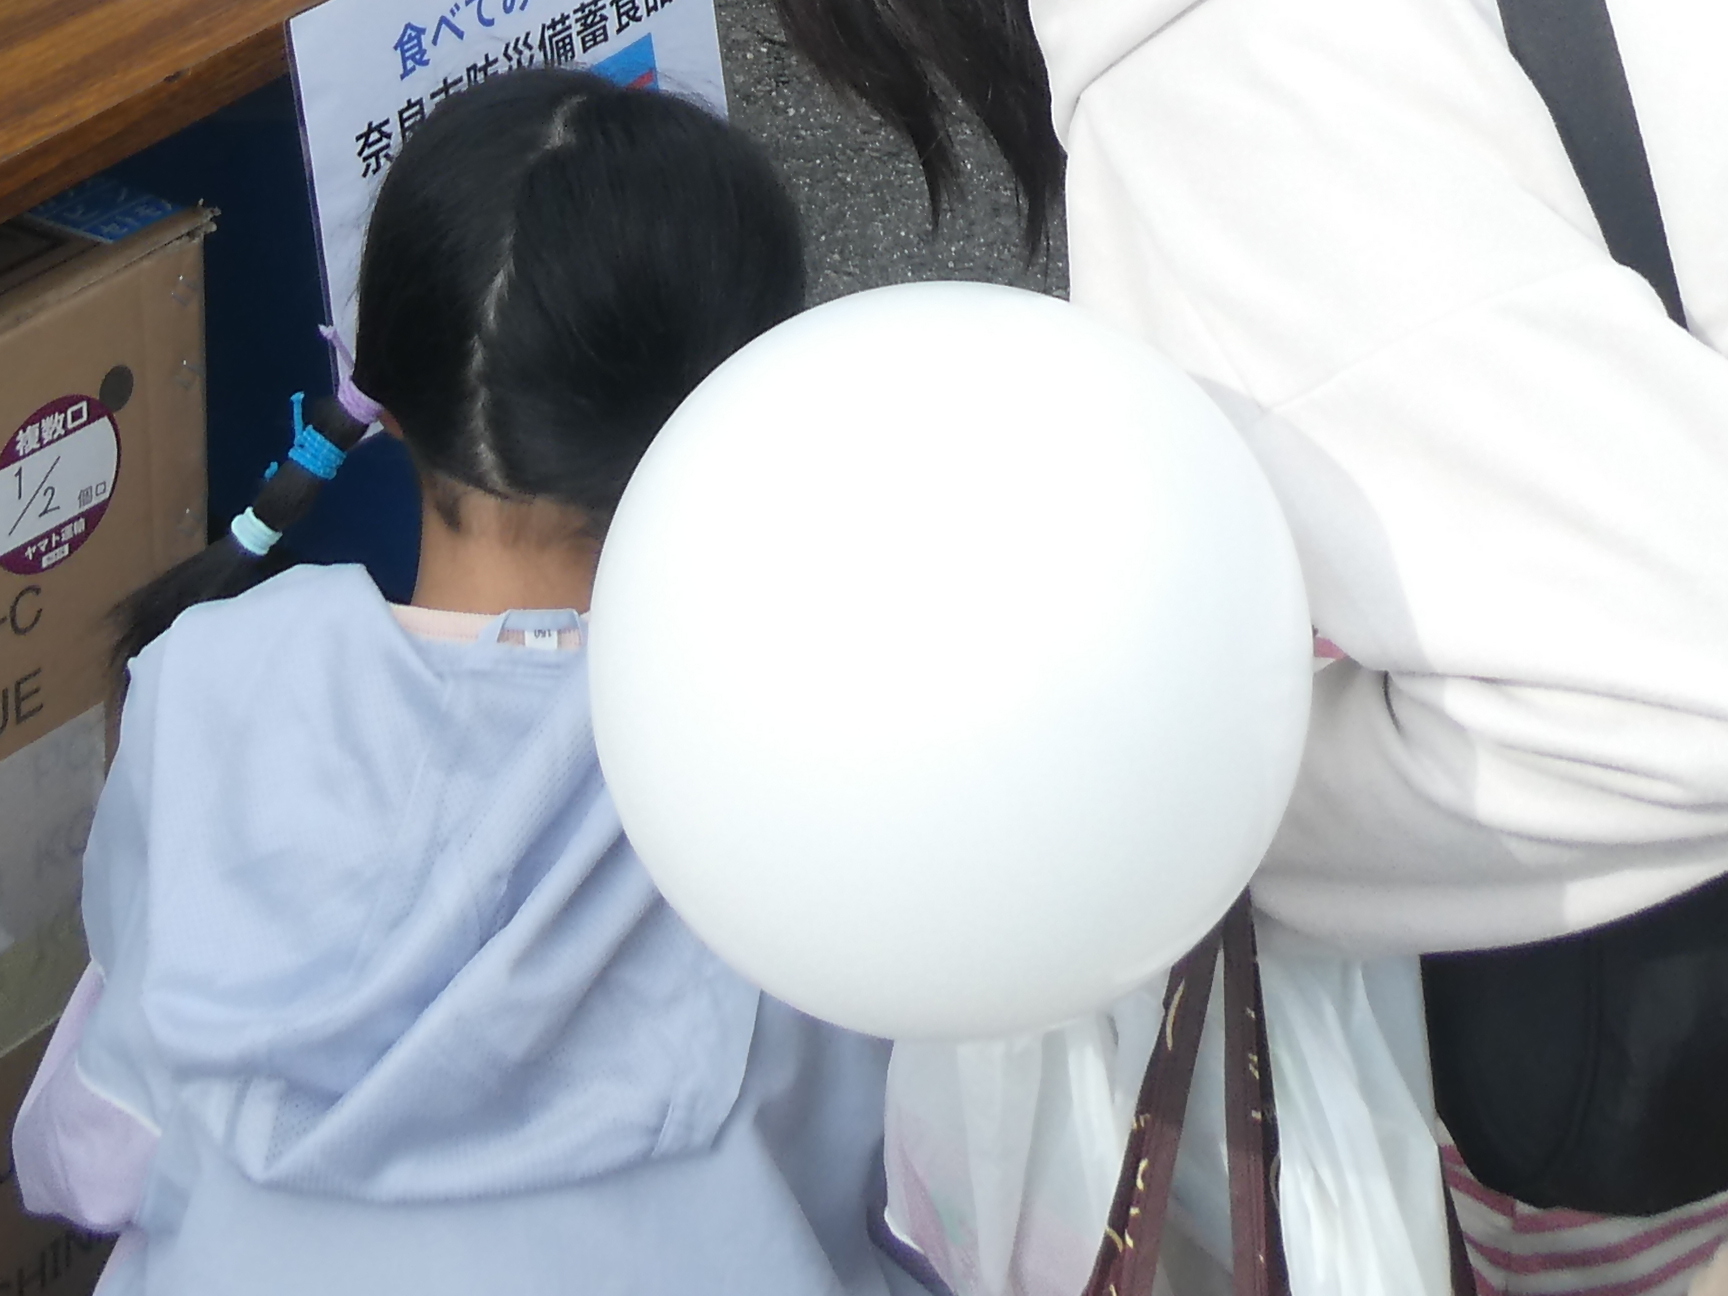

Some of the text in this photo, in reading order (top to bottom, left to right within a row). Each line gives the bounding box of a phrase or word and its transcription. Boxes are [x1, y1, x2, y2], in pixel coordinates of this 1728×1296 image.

[15, 400, 89, 457] 複数口
[24, 517, 87, 561] ヤマト運輸
